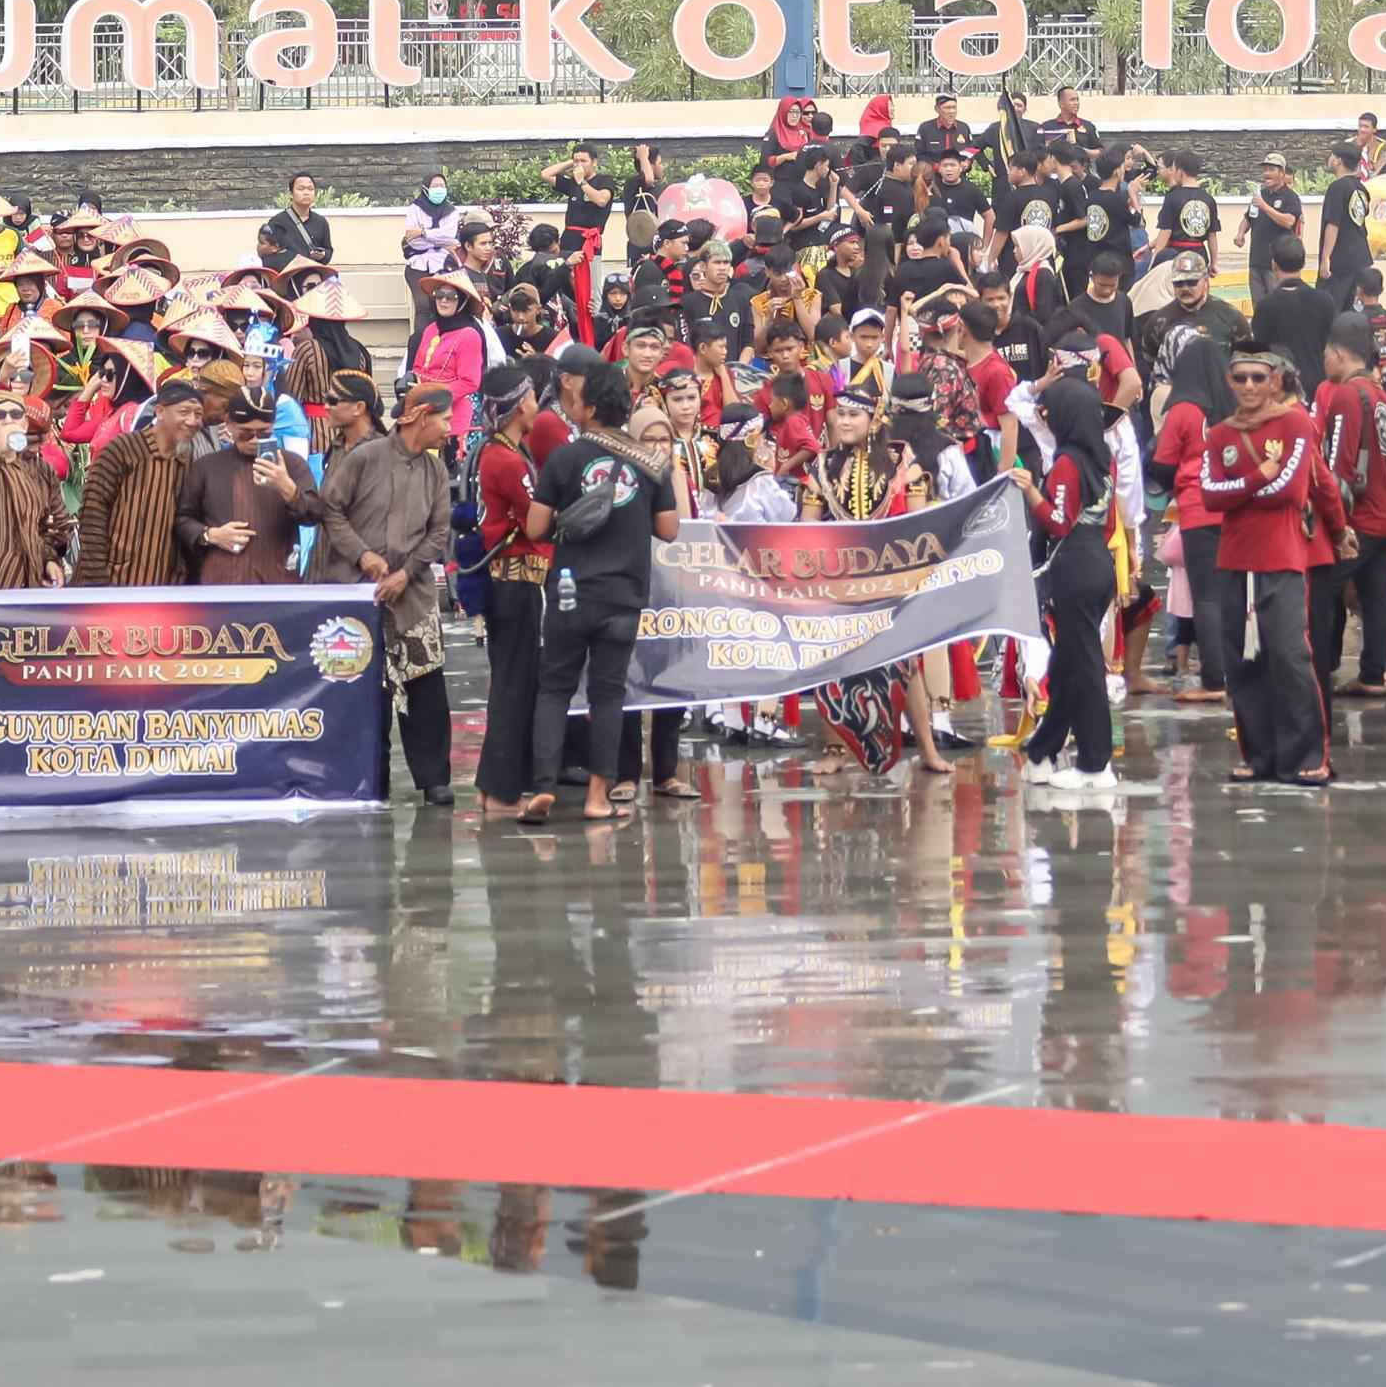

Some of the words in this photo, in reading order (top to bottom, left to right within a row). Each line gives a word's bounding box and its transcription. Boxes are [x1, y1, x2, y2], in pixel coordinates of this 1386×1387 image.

[656, 540, 788, 580] GELAR
[792, 532, 950, 581] BUDAYA
[699, 574, 767, 598] PANJI
[637, 607, 781, 640] RONGGO
[123, 622, 296, 662] BUDAYA
[708, 640, 798, 670] KOTA
[22, 664, 93, 682] PANJI
[105, 664, 169, 682] FAIR
[175, 663, 245, 679] 2024
[143, 707, 325, 743] BANYUMAS
[26, 744, 121, 777] KOTA
[123, 742, 238, 776] DUMAI
